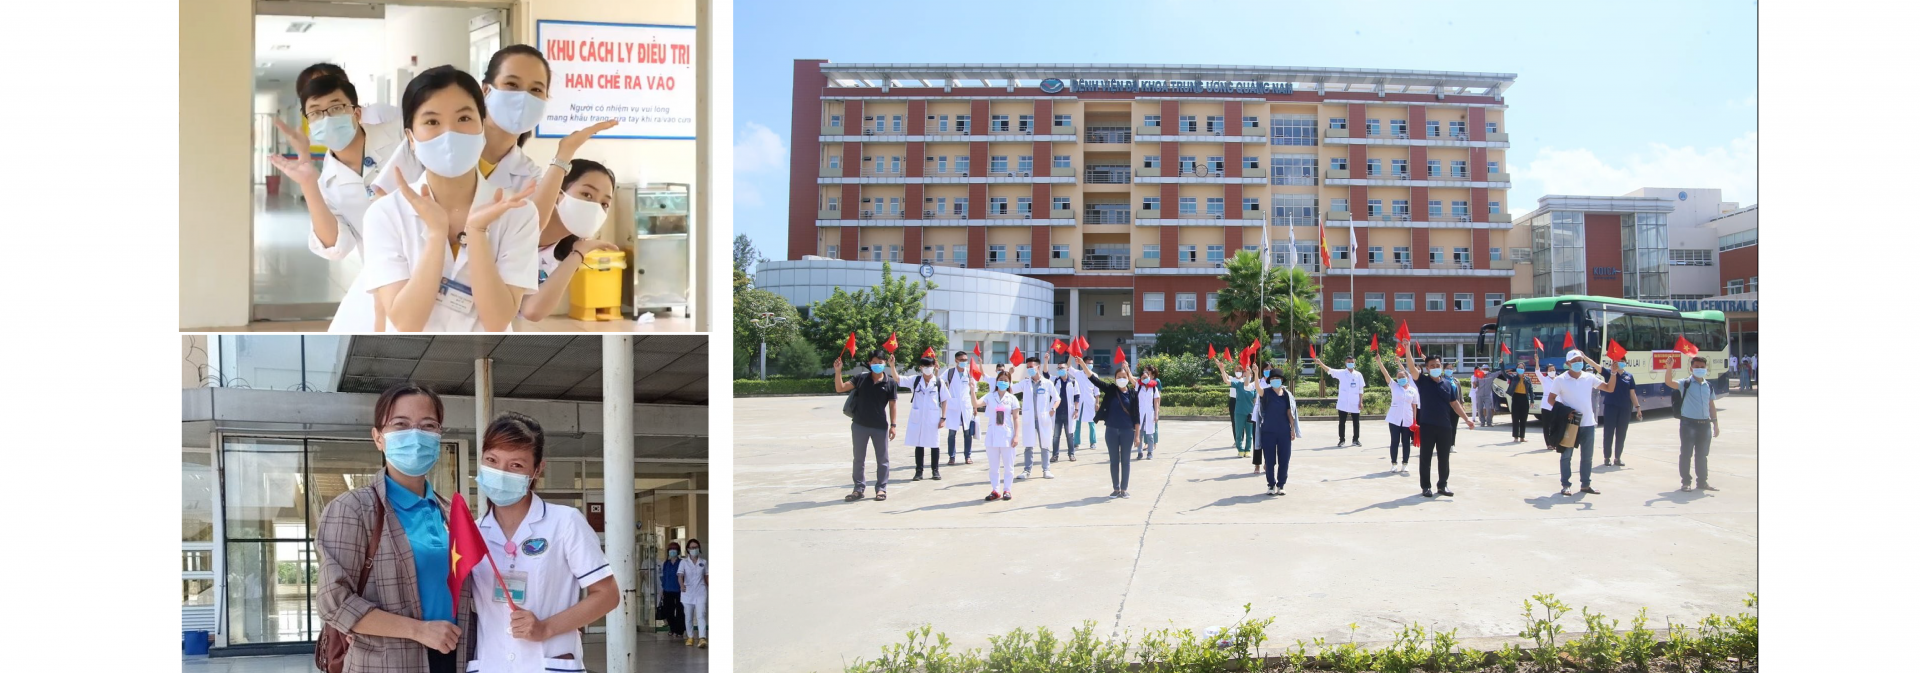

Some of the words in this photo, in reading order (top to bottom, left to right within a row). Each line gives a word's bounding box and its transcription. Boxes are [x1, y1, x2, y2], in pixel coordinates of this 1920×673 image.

[547, 39, 575, 61] KHU
[579, 37, 614, 62] CÁCH
[618, 42, 634, 63] LY
[638, 36, 666, 64] ĐIỀU
[671, 44, 690, 69] TRỊ
[565, 73, 593, 91] HẠN
[625, 75, 642, 90] RA
[1072, 78, 1098, 93] BỆNH
[1102, 78, 1124, 93] VIỆN
[1141, 80, 1168, 92] KHOA
[1170, 81, 1203, 93] TRUNG
[1206, 80, 1233, 93] ƯƠNG
[1236, 79, 1269, 94] QUẢNG
[1272, 82, 1293, 94] NAM
[570, 103, 593, 113] Người
[606, 104, 628, 113] nhiệm
[641, 105, 653, 113] vui
[547, 115, 568, 123] mang
[628, 115, 639, 124] tay
[641, 115, 652, 123] khi
[1593, 266, 1616, 275] KOICA
[1673, 300, 1697, 312] NAM
[1701, 300, 1749, 312] CENTRAL
